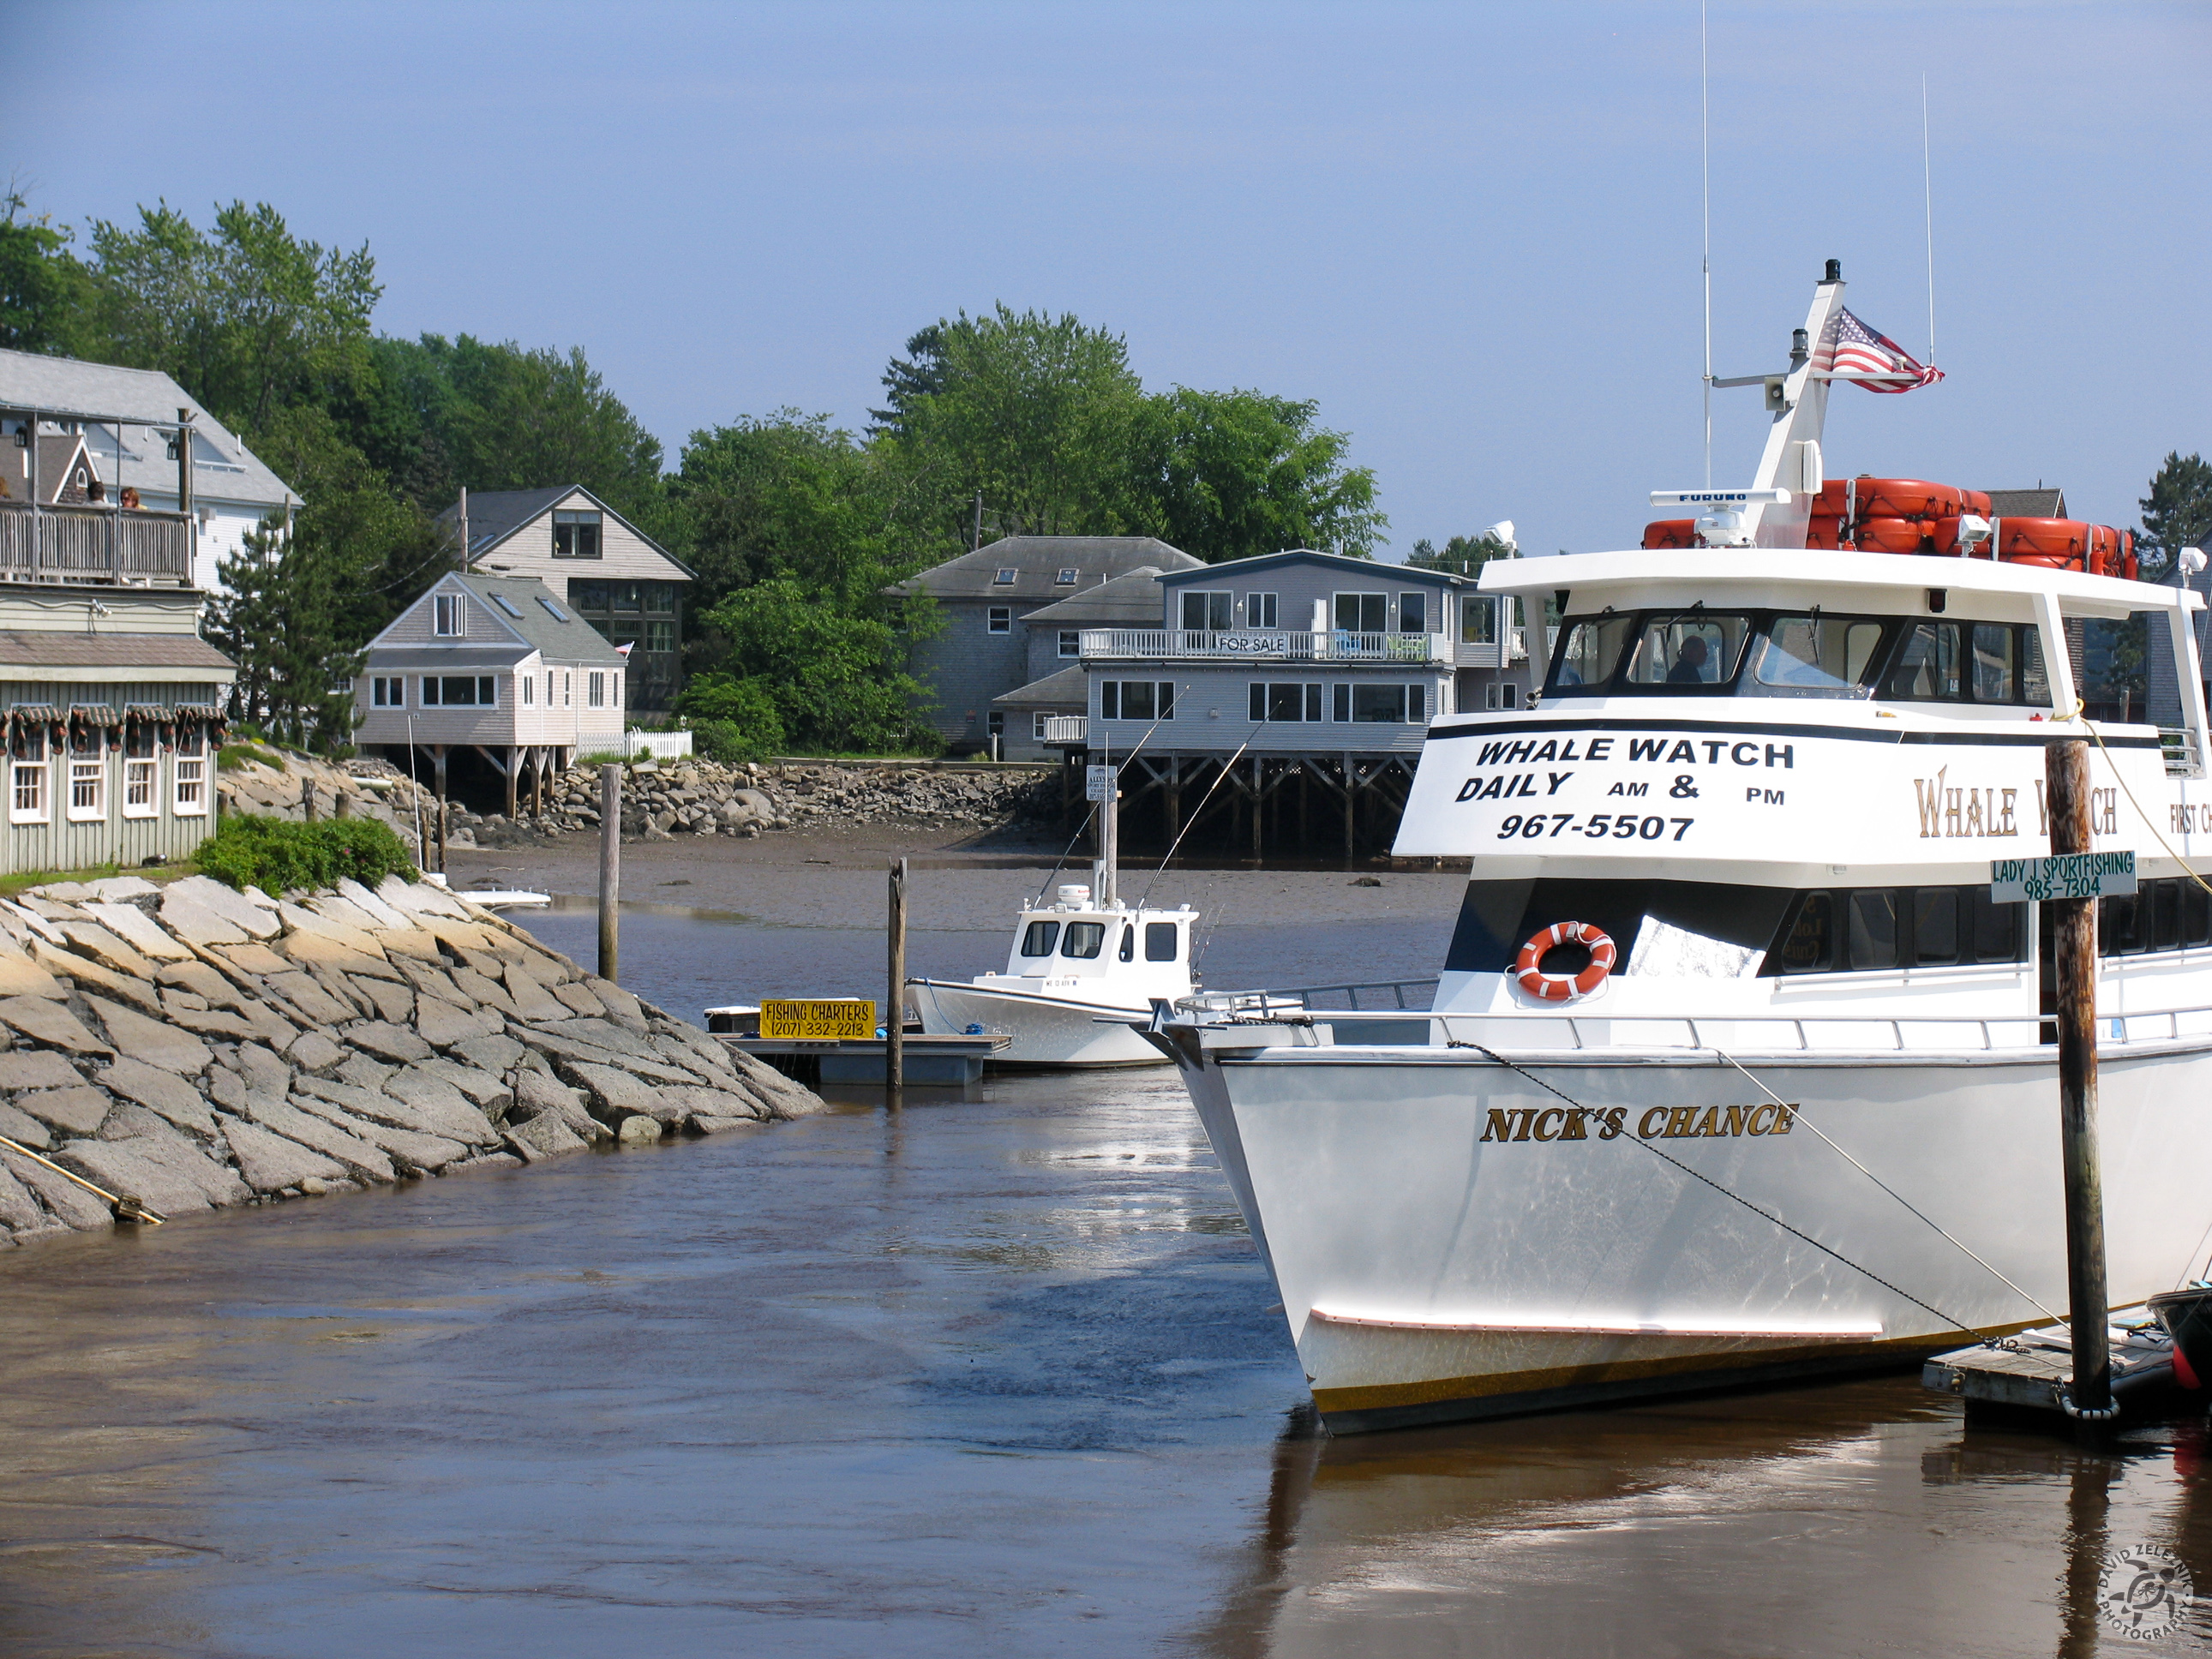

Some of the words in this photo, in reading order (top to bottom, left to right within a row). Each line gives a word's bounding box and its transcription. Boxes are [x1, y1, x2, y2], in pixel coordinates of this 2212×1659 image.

[1679, 494, 1747, 502] FURUNO
[1220, 638, 1249, 651] FOR
[1253, 638, 1284, 651] SALE
[1476, 739, 1615, 766] WHALE
[1629, 739, 1794, 769] WATCH
[1455, 772, 1575, 801] DAILY
[1607, 782, 1649, 796] AM
[1669, 775, 1700, 799] &
[1747, 788, 1784, 806] PM
[1914, 764, 2018, 837] WHALE
[1497, 813, 1694, 841] 967-5507
[2170, 804, 2197, 835] FIRST
[1993, 859, 2026, 883] LADY
[2030, 858, 2037, 882] J
[2043, 851, 2133, 880] SPORTFISHING
[2023, 877, 2101, 901] 985-7304
[766, 1003, 807, 1021] FISHING
[811, 1003, 869, 1021] CHARTERS
[771, 1022, 800, 1036] (207)
[806, 1022, 864, 1036] 332-2213
[1479, 1106, 1628, 1142] NICK'S
[1638, 1104, 1800, 1139] CHANCE
